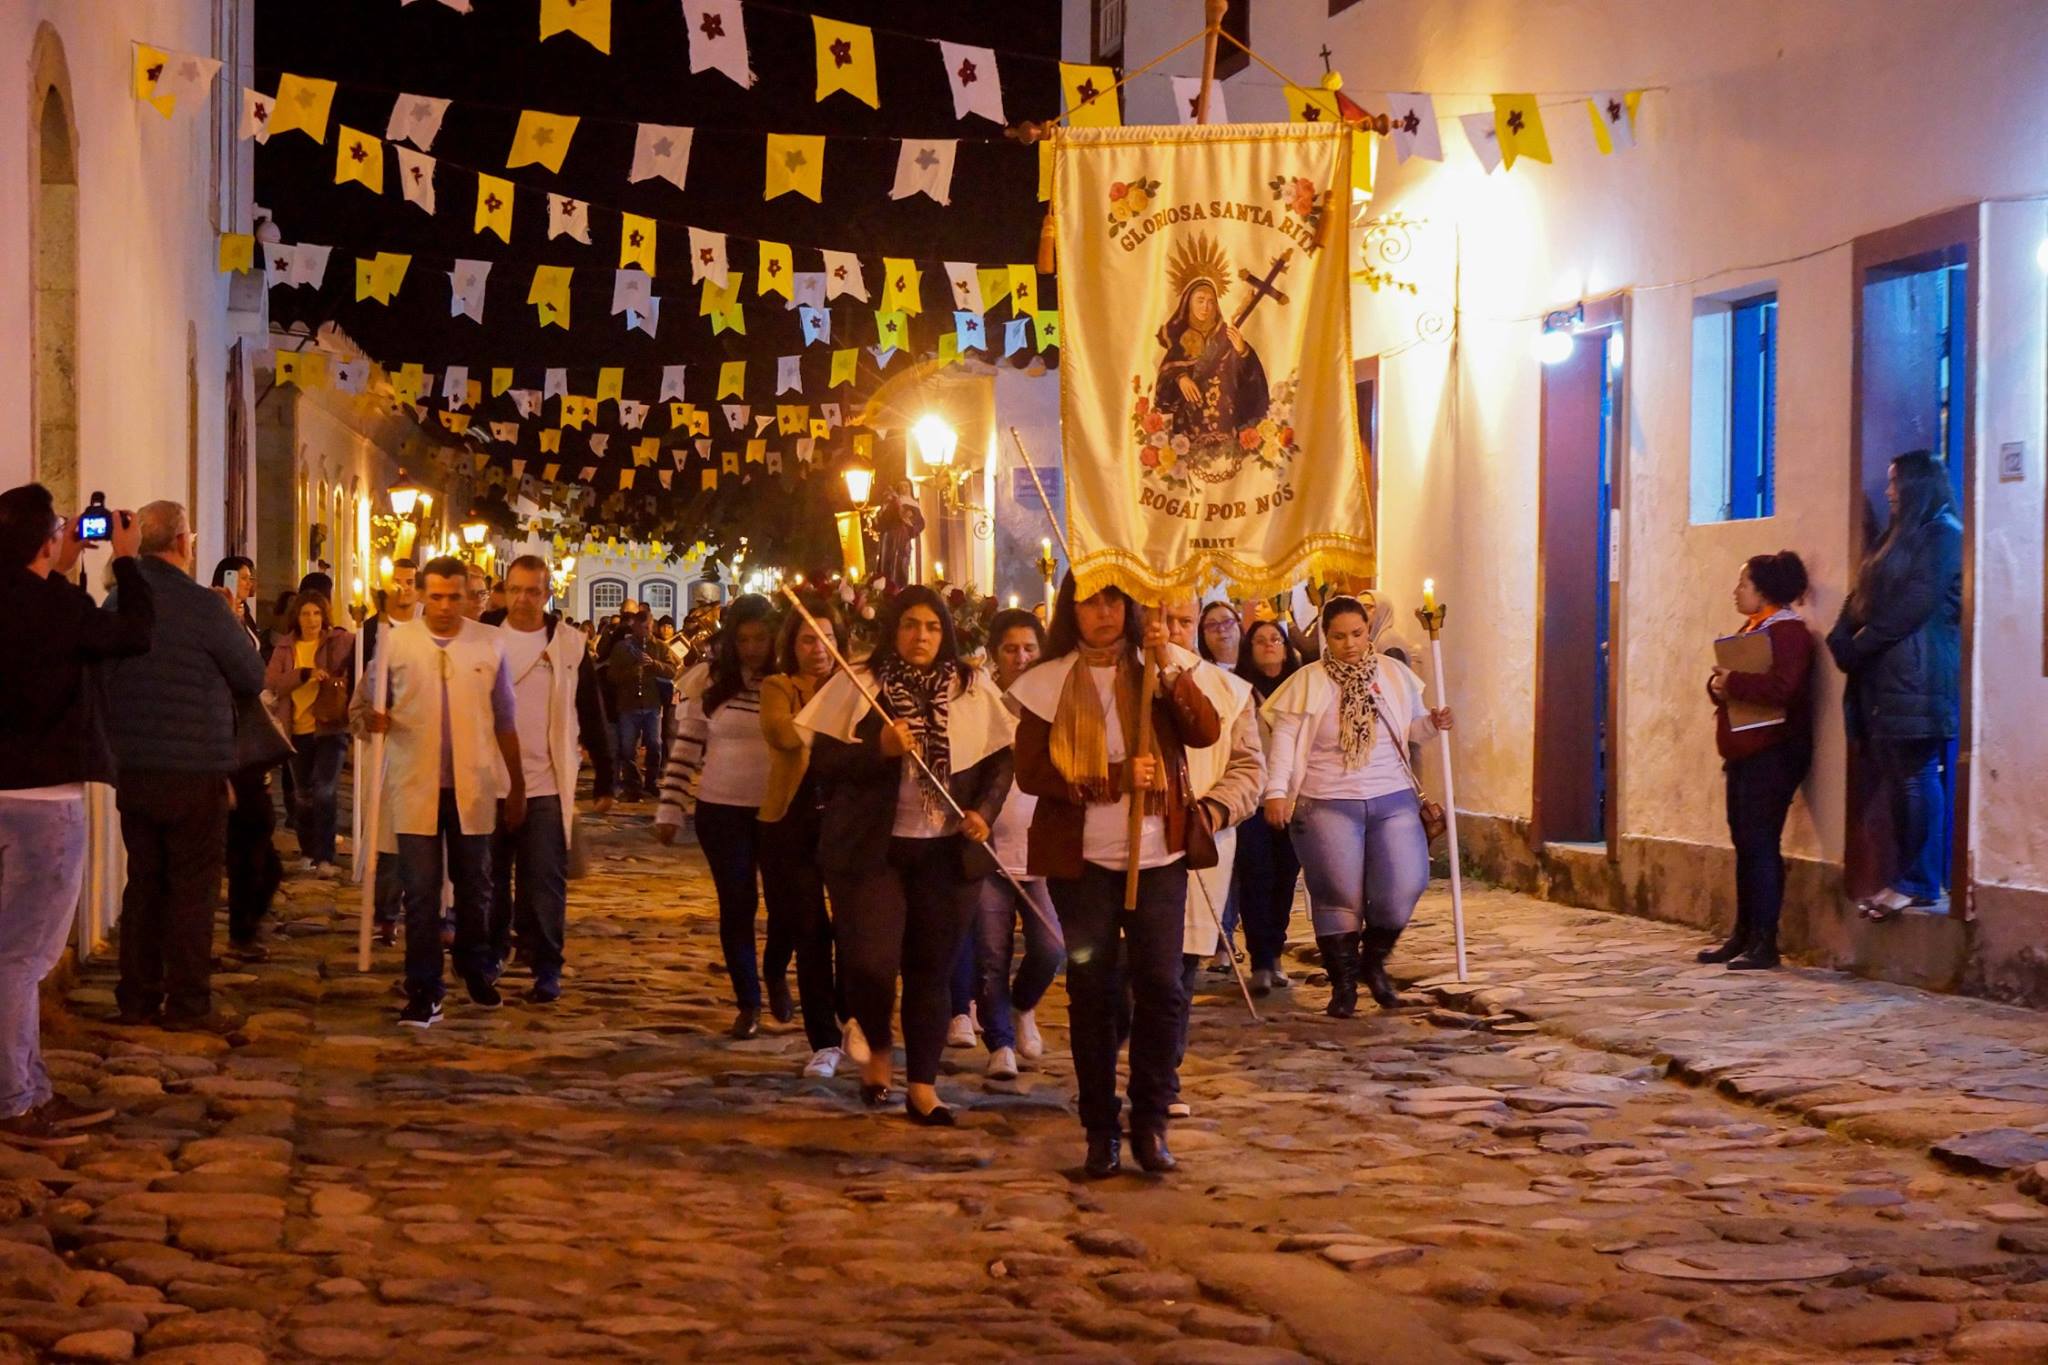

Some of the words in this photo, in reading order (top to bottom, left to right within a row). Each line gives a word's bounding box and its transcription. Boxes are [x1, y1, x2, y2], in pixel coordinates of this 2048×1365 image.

[1120, 202, 1207, 252] GLORIOSA
[1209, 201, 1275, 228] SANTA
[1138, 487, 1199, 520] ROGAI
[1204, 501, 1247, 521] POR
[1255, 482, 1295, 515] NÓS
